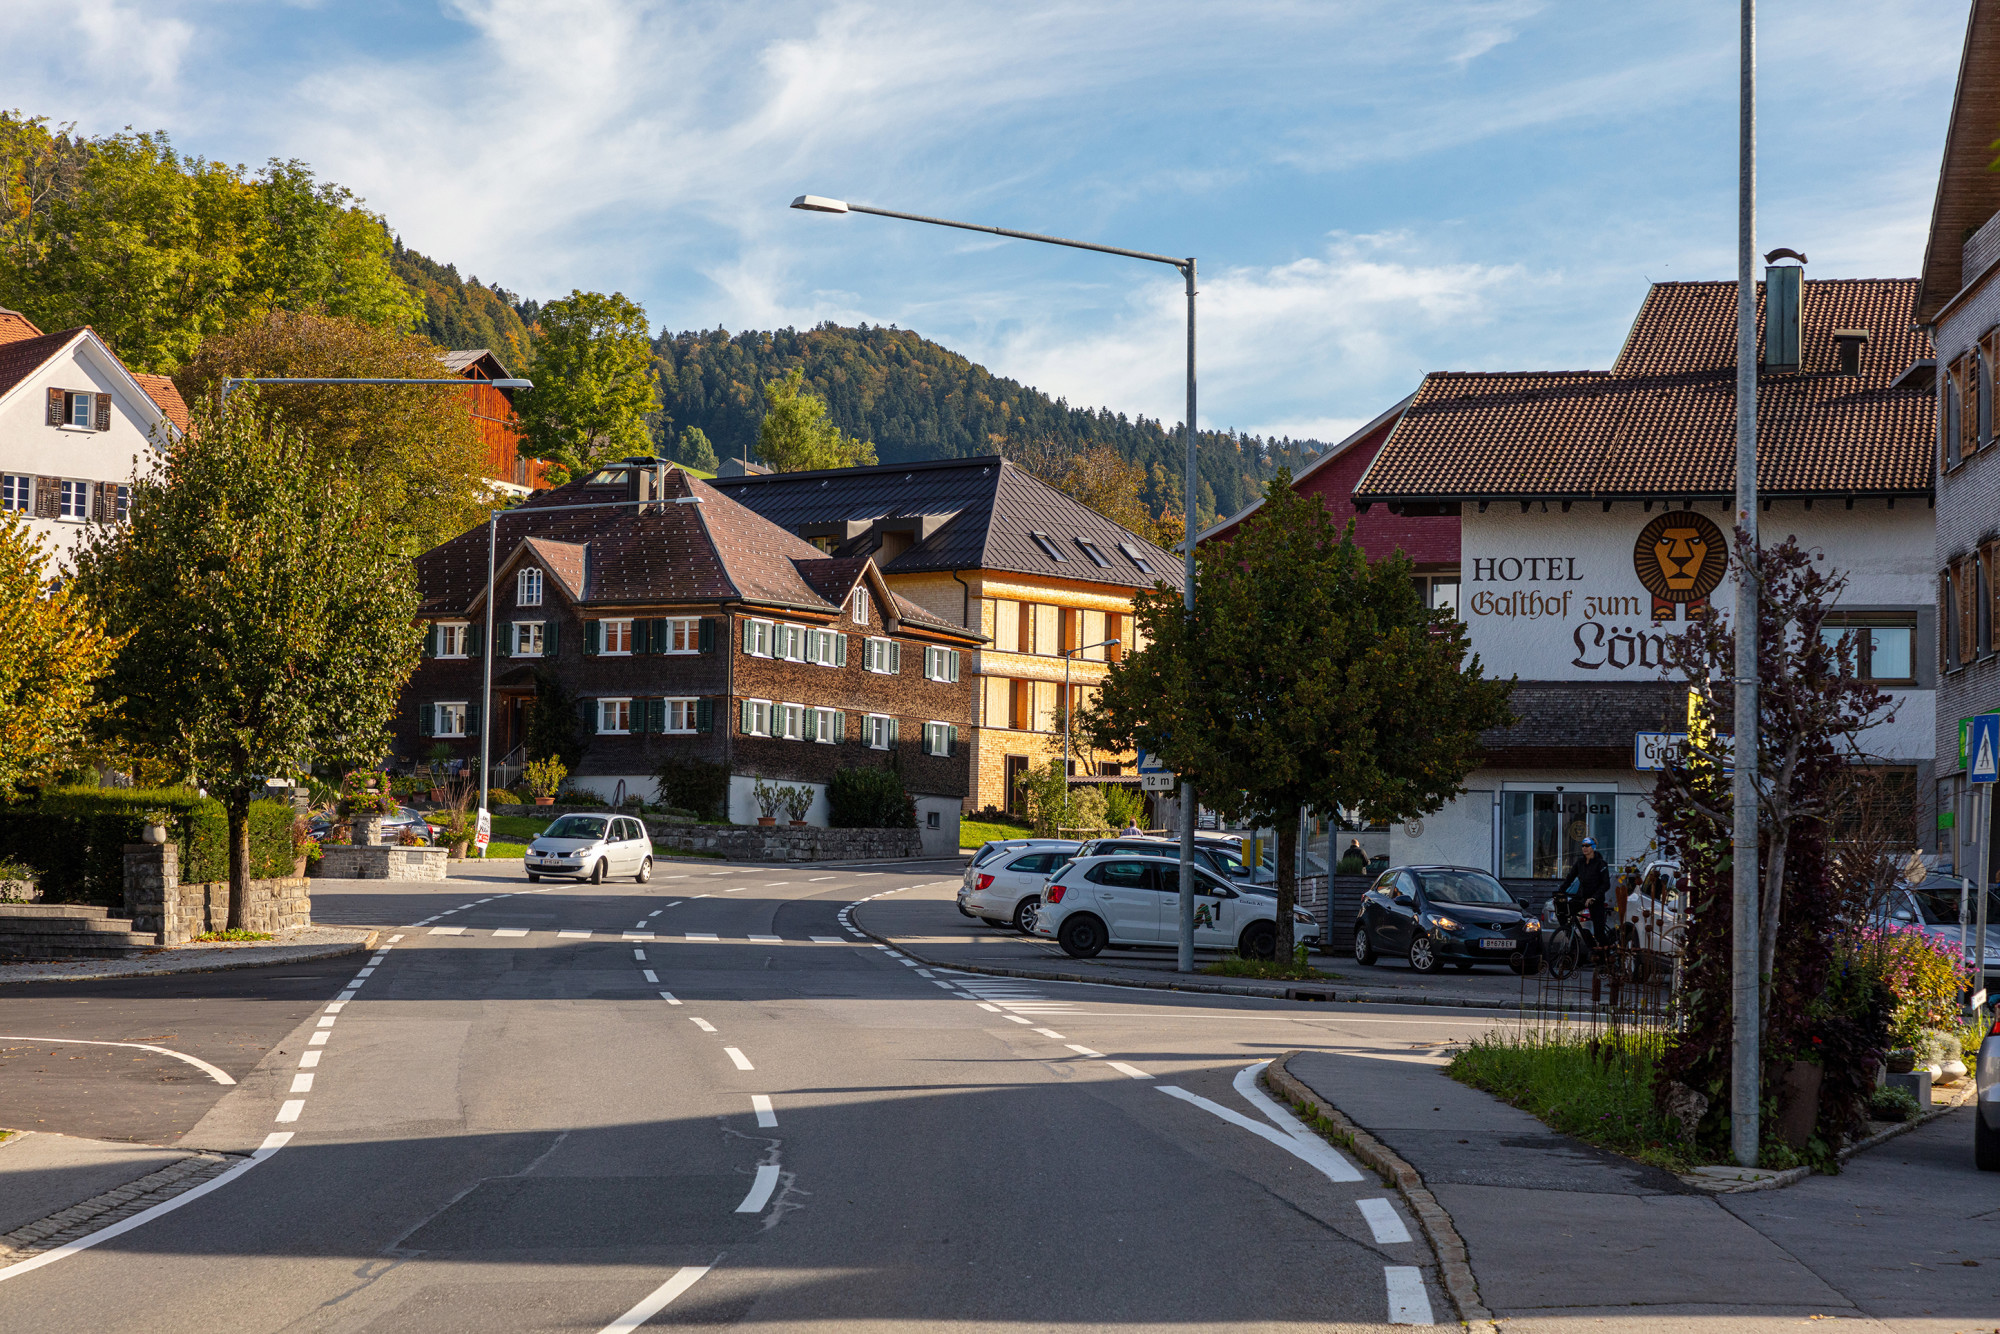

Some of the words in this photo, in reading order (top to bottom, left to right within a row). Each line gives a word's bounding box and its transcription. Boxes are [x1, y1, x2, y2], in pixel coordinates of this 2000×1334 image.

[1472, 557, 1584, 582] HOTEL
[1583, 595, 1643, 620] zum
[1146, 776, 1156, 786] 12
[1160, 777, 1170, 786] m
